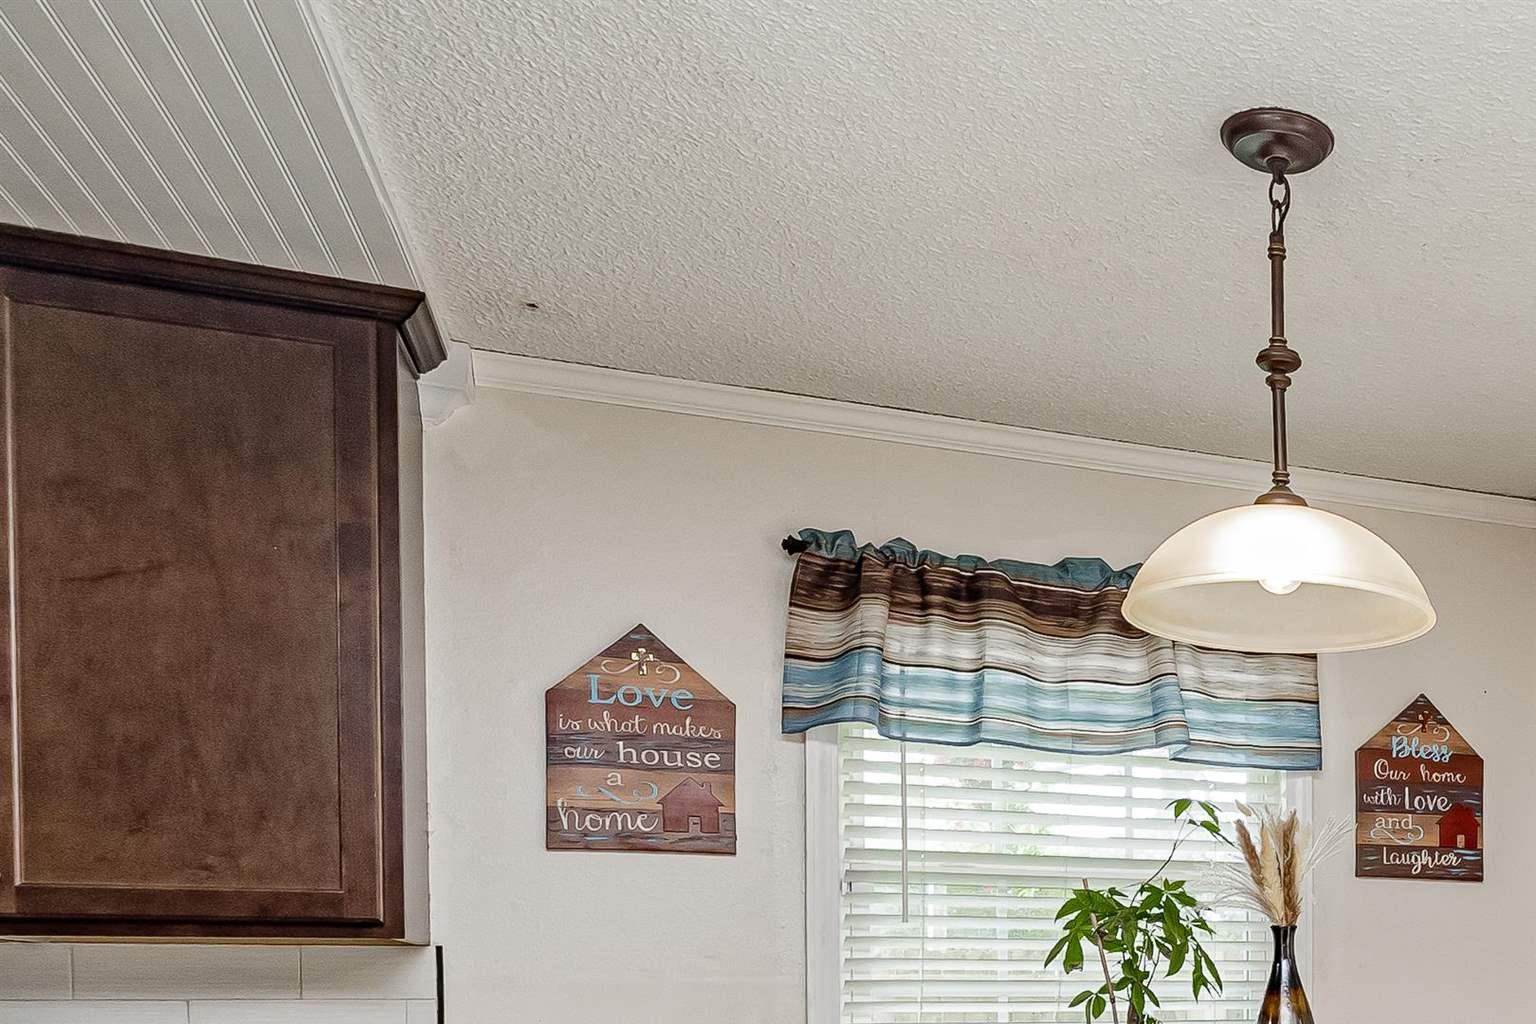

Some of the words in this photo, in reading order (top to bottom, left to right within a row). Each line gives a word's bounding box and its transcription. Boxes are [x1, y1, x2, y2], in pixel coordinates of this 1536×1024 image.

[586, 672, 694, 710] Love
[558, 713, 582, 730] is
[588, 710, 648, 735] what
[652, 716, 722, 740] makes
[564, 745, 605, 760] our
[615, 741, 721, 769] house
[1391, 735, 1454, 763] Bless
[606, 771, 623, 786] a
[1373, 758, 1411, 781] Our
[1419, 763, 1467, 784] home
[1363, 786, 1401, 806] with
[1404, 786, 1453, 812] Love
[556, 797, 660, 832] home
[1374, 813, 1415, 830] and
[1382, 846, 1462, 875] Laughter
